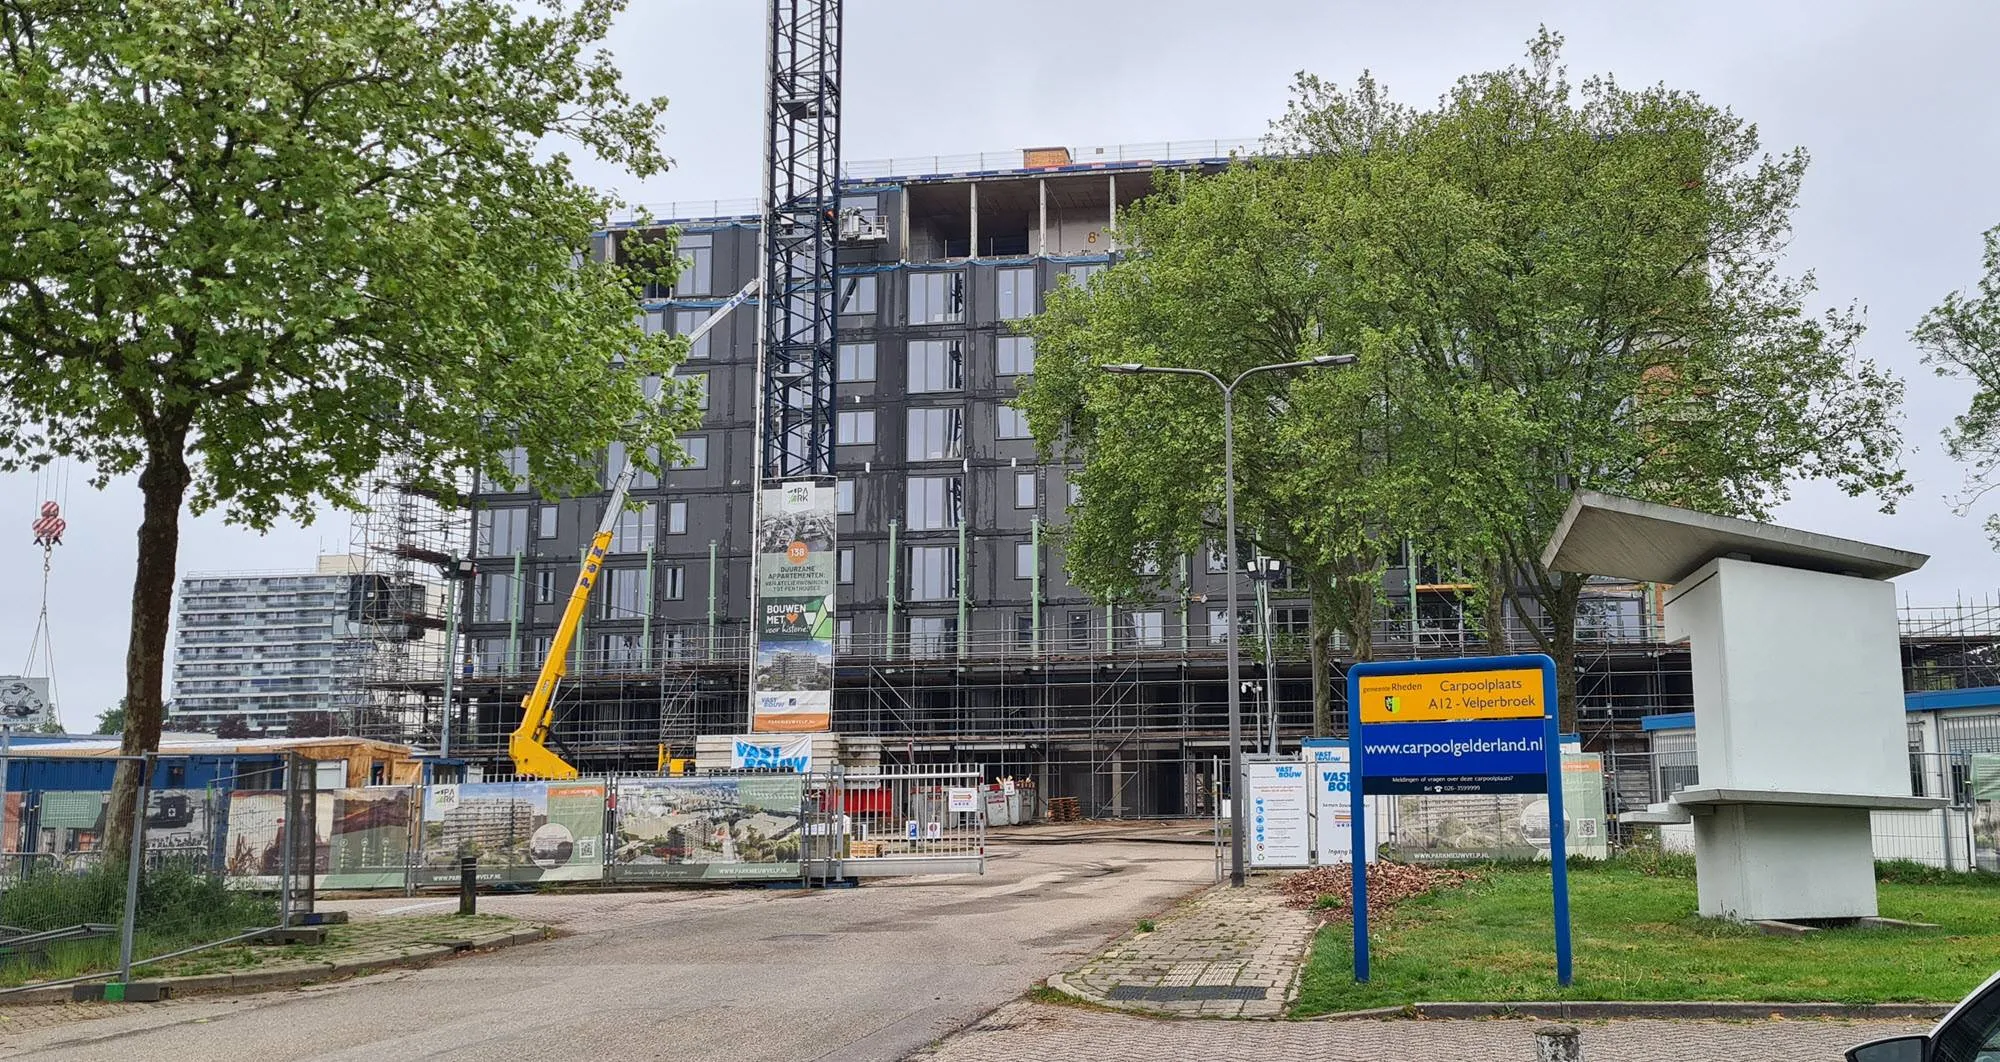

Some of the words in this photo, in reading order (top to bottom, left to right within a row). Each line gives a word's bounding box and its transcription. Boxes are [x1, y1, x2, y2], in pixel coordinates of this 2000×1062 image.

[791, 548, 805, 557] 138
[766, 604, 807, 614] BOUWEN
[766, 615, 786, 625] MET
[1391, 683, 1422, 691] Rheden
[1440, 679, 1522, 694] Carpoolplaats
[1428, 698, 1452, 710] A12
[1462, 695, 1536, 711] Velperbroek
[736, 741, 781, 758] VAST
[1364, 737, 1543, 758] www.carpoolgelderland.nl
[1474, 775, 1514, 783] carpoolplaats?
